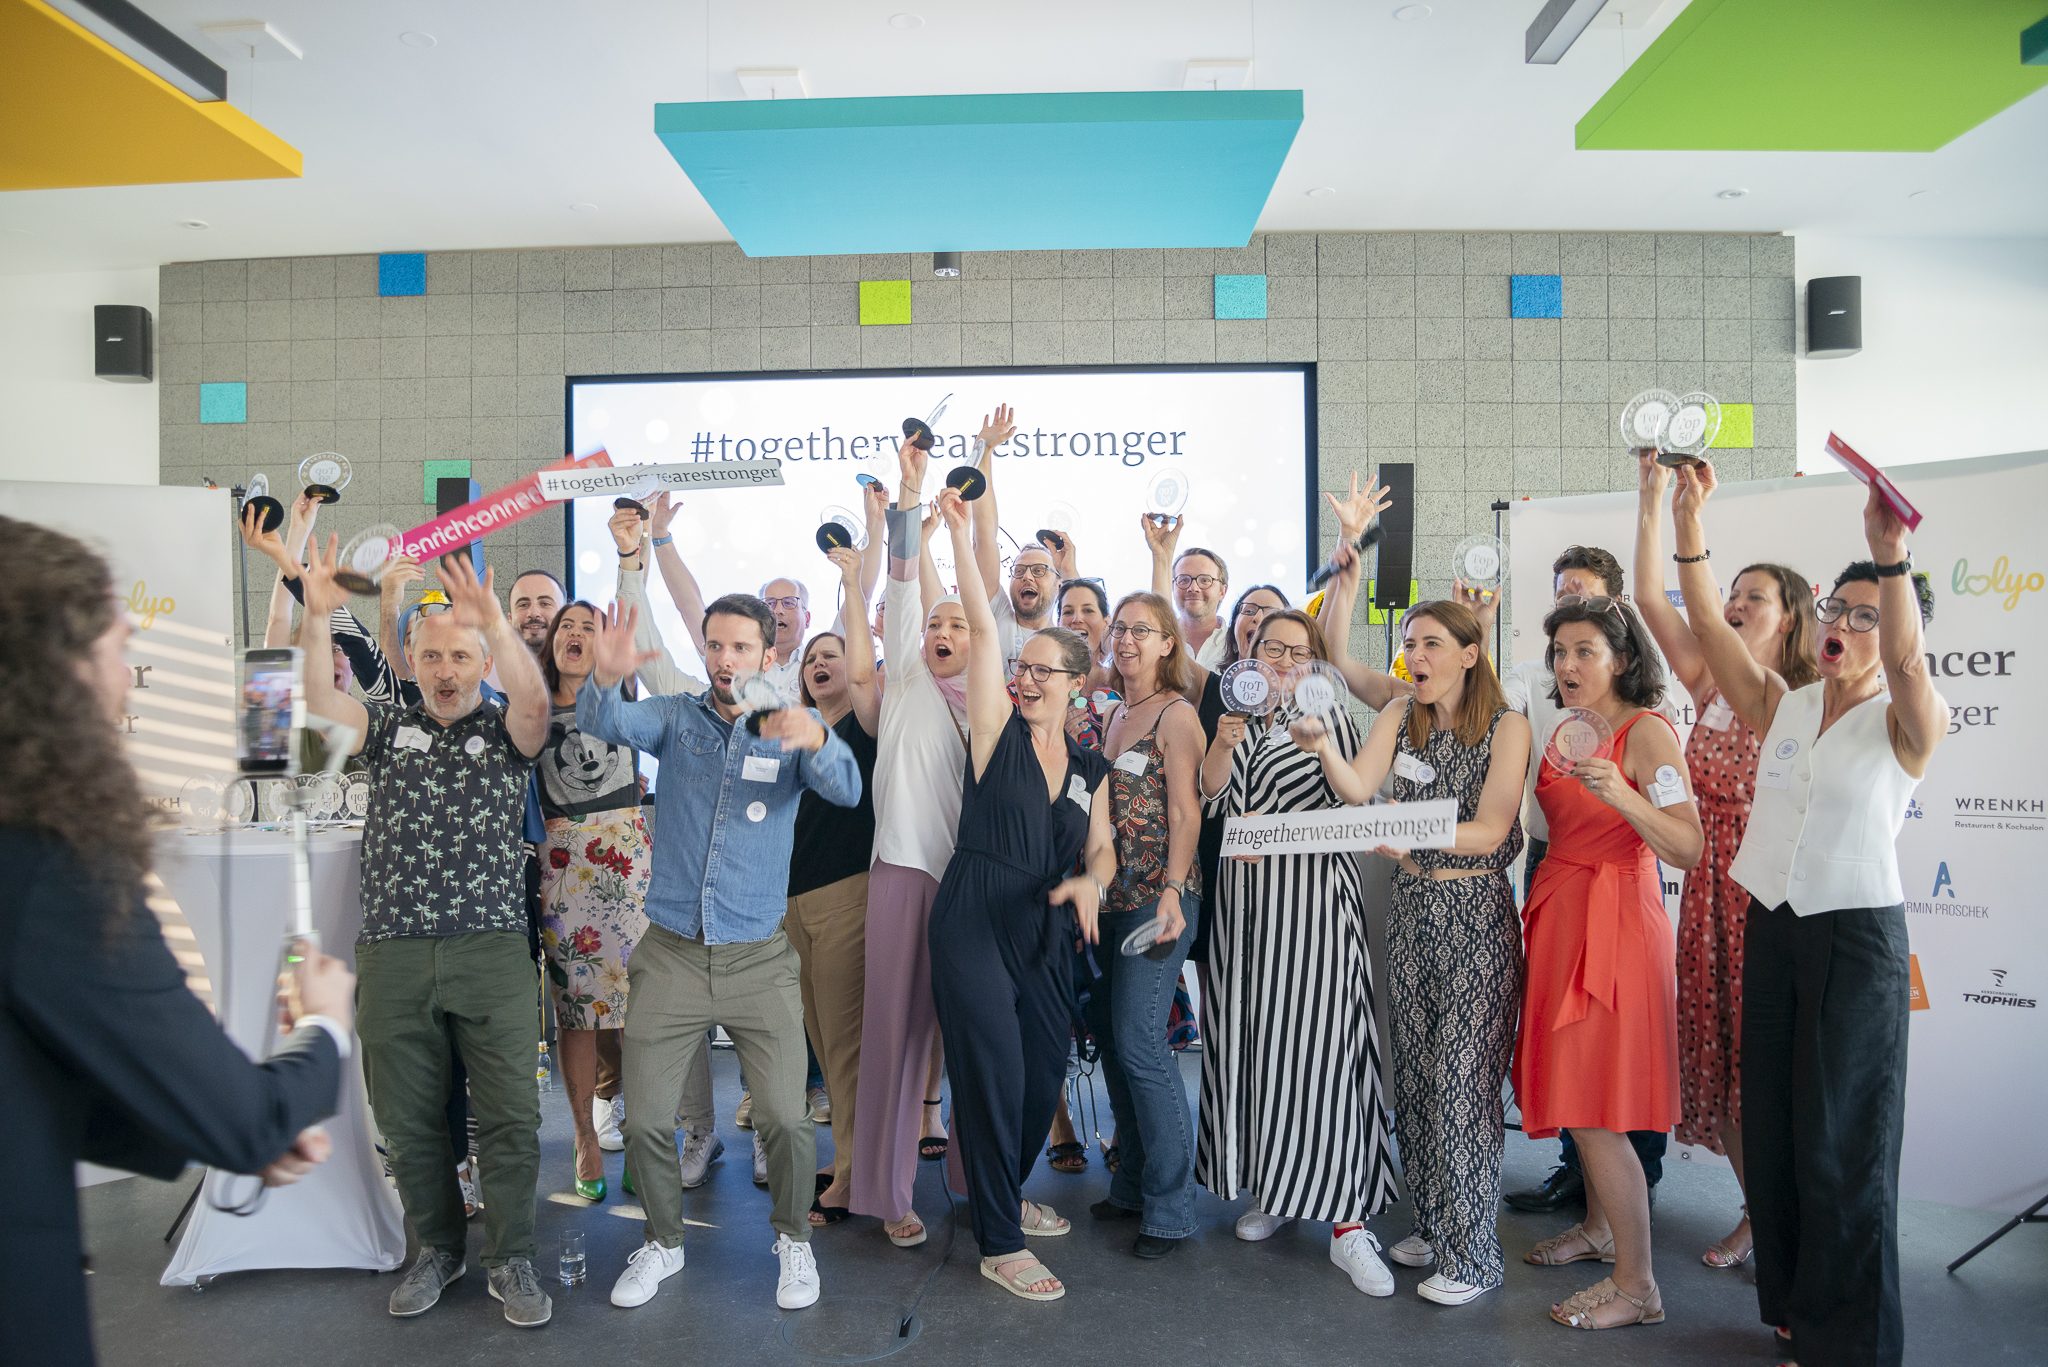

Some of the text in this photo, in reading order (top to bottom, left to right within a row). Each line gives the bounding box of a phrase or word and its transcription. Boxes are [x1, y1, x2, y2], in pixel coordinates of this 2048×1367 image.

[690, 426, 1186, 467] #togethereaestronger
[1955, 797, 2044, 813] WRENKH
[1226, 816, 1450, 850] #togetherwearestronger
[1954, 820, 2044, 831] Restaurant & Kochsalon
[1935, 903, 1989, 919] PROSCHEK
[1963, 993, 2037, 1009] TROPHIES
